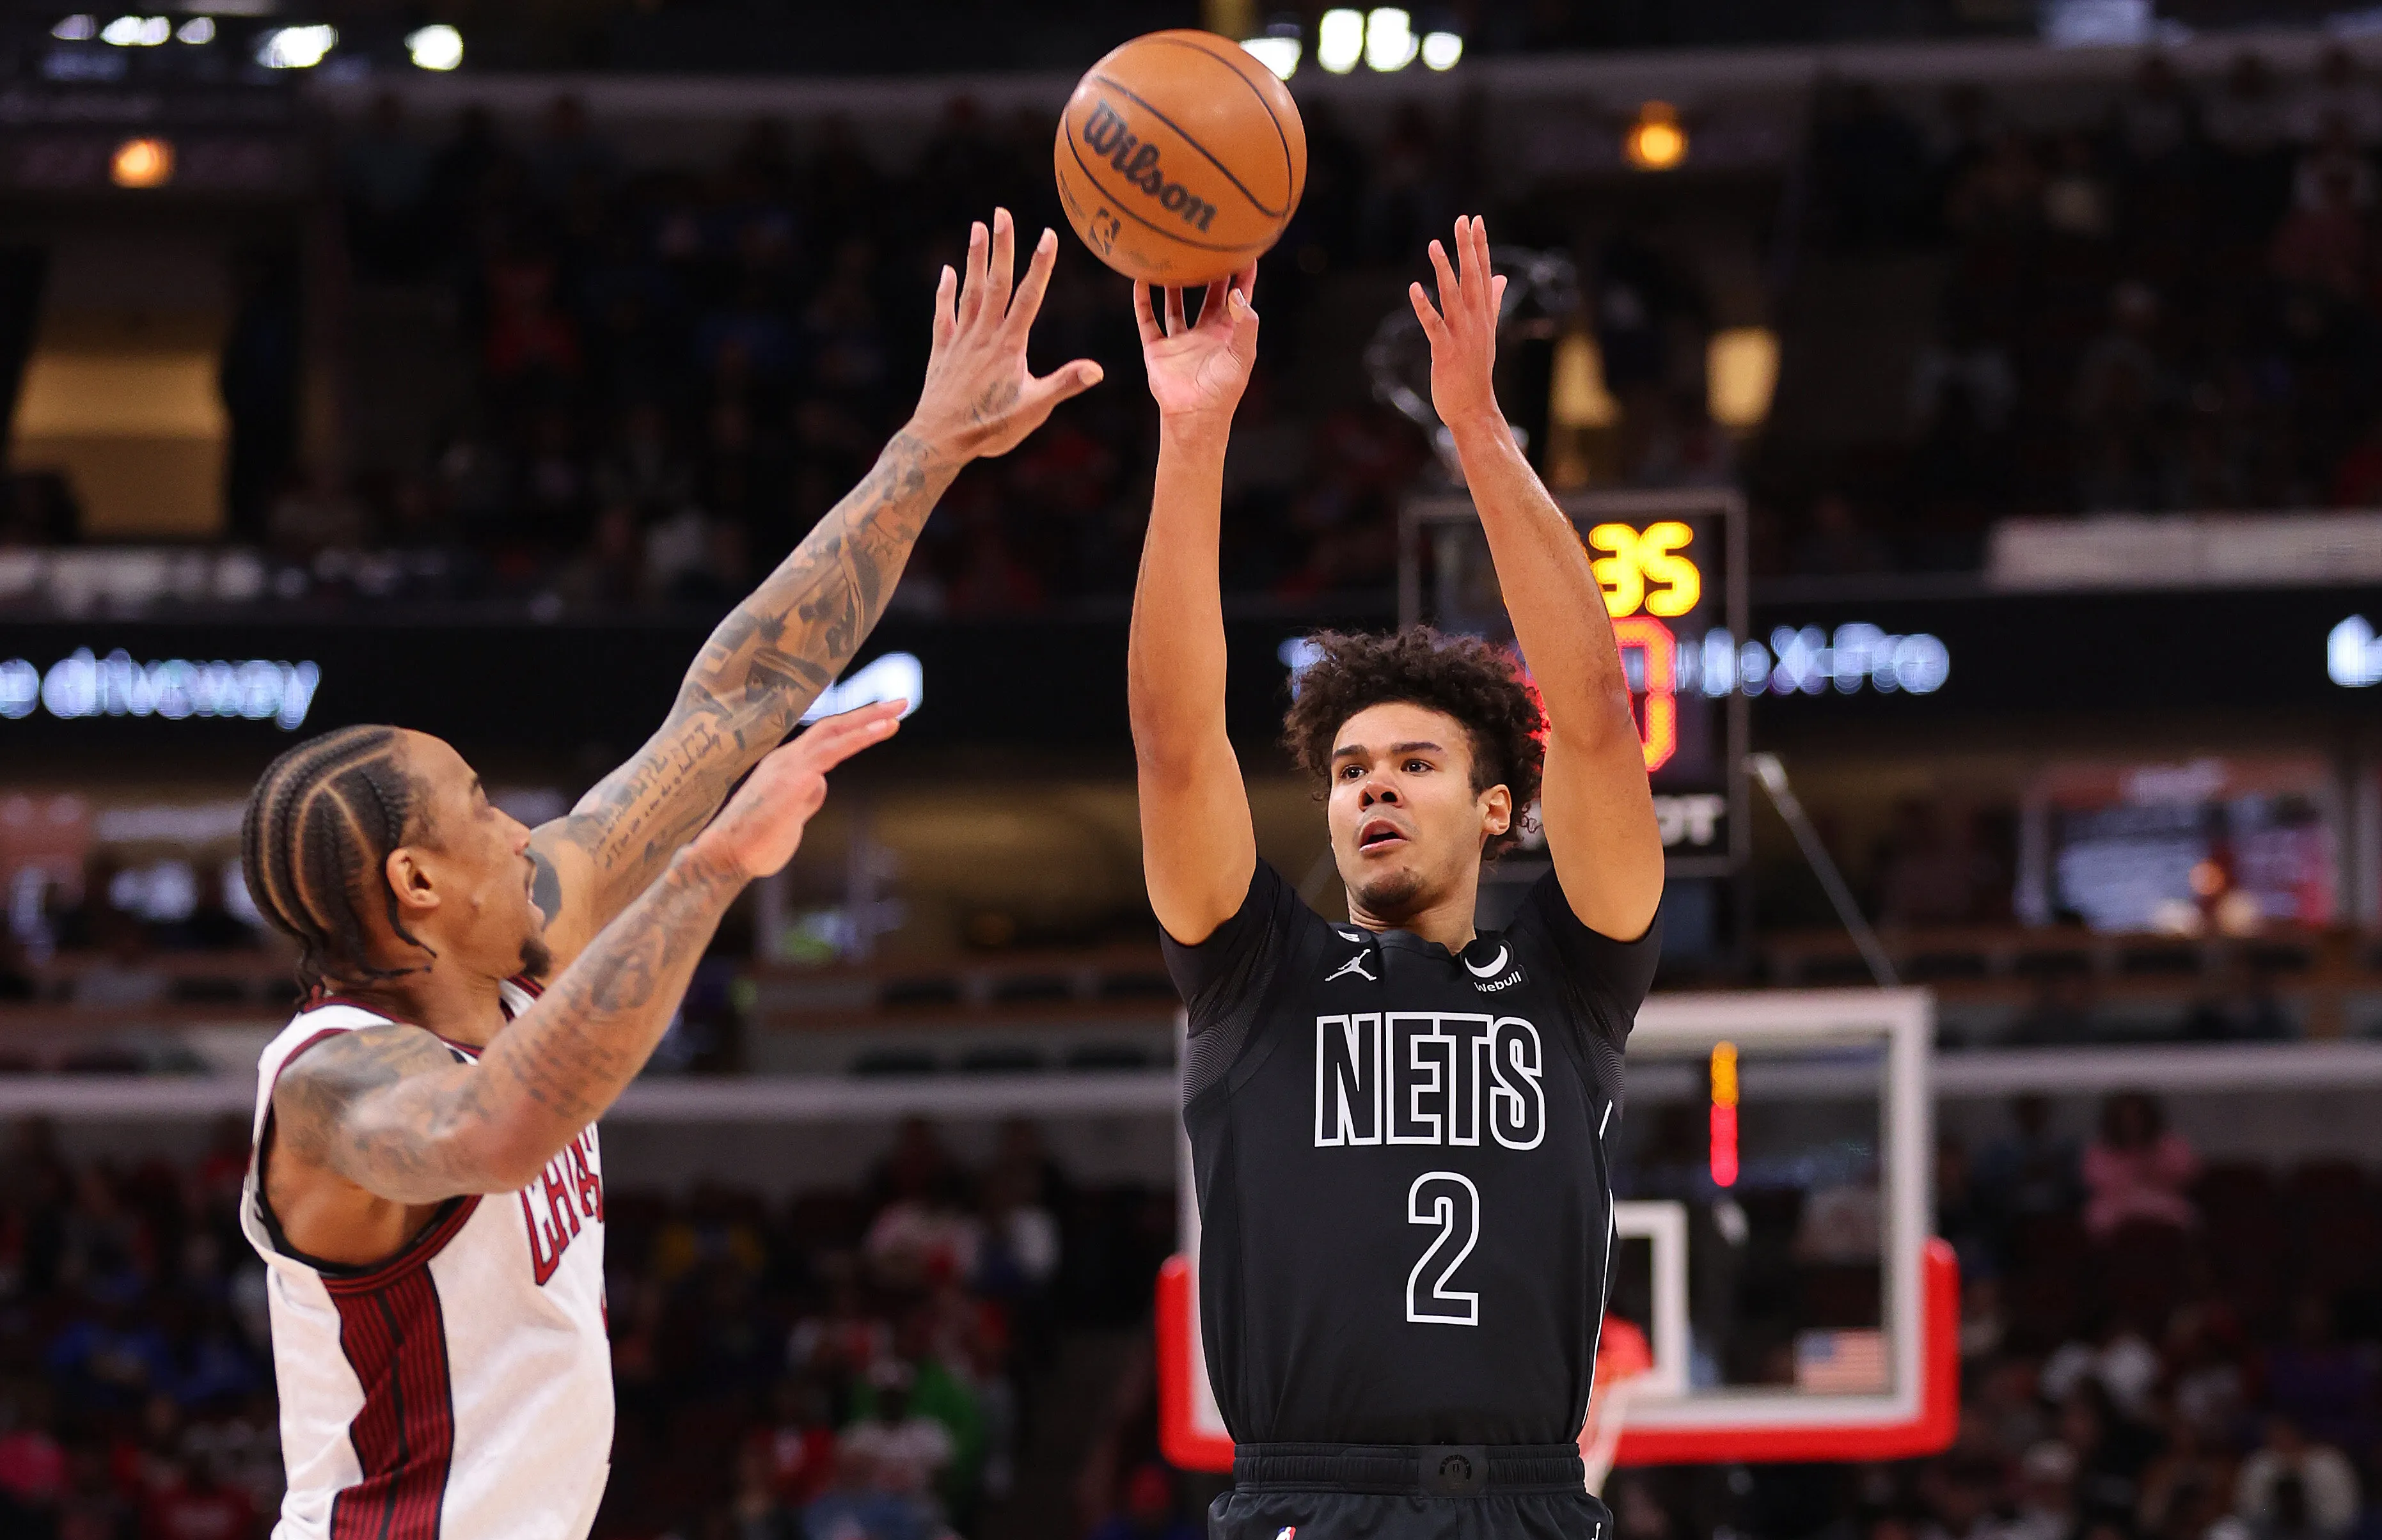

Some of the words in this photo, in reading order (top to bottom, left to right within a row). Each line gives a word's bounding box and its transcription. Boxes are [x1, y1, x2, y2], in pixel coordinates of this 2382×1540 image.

[1084, 98, 1218, 233] Wilson
[41, 646, 321, 730] driveway
[1473, 970, 1522, 993] Webull
[1314, 1012, 1546, 1151] NETS
[1407, 1171, 1479, 1326] 2
